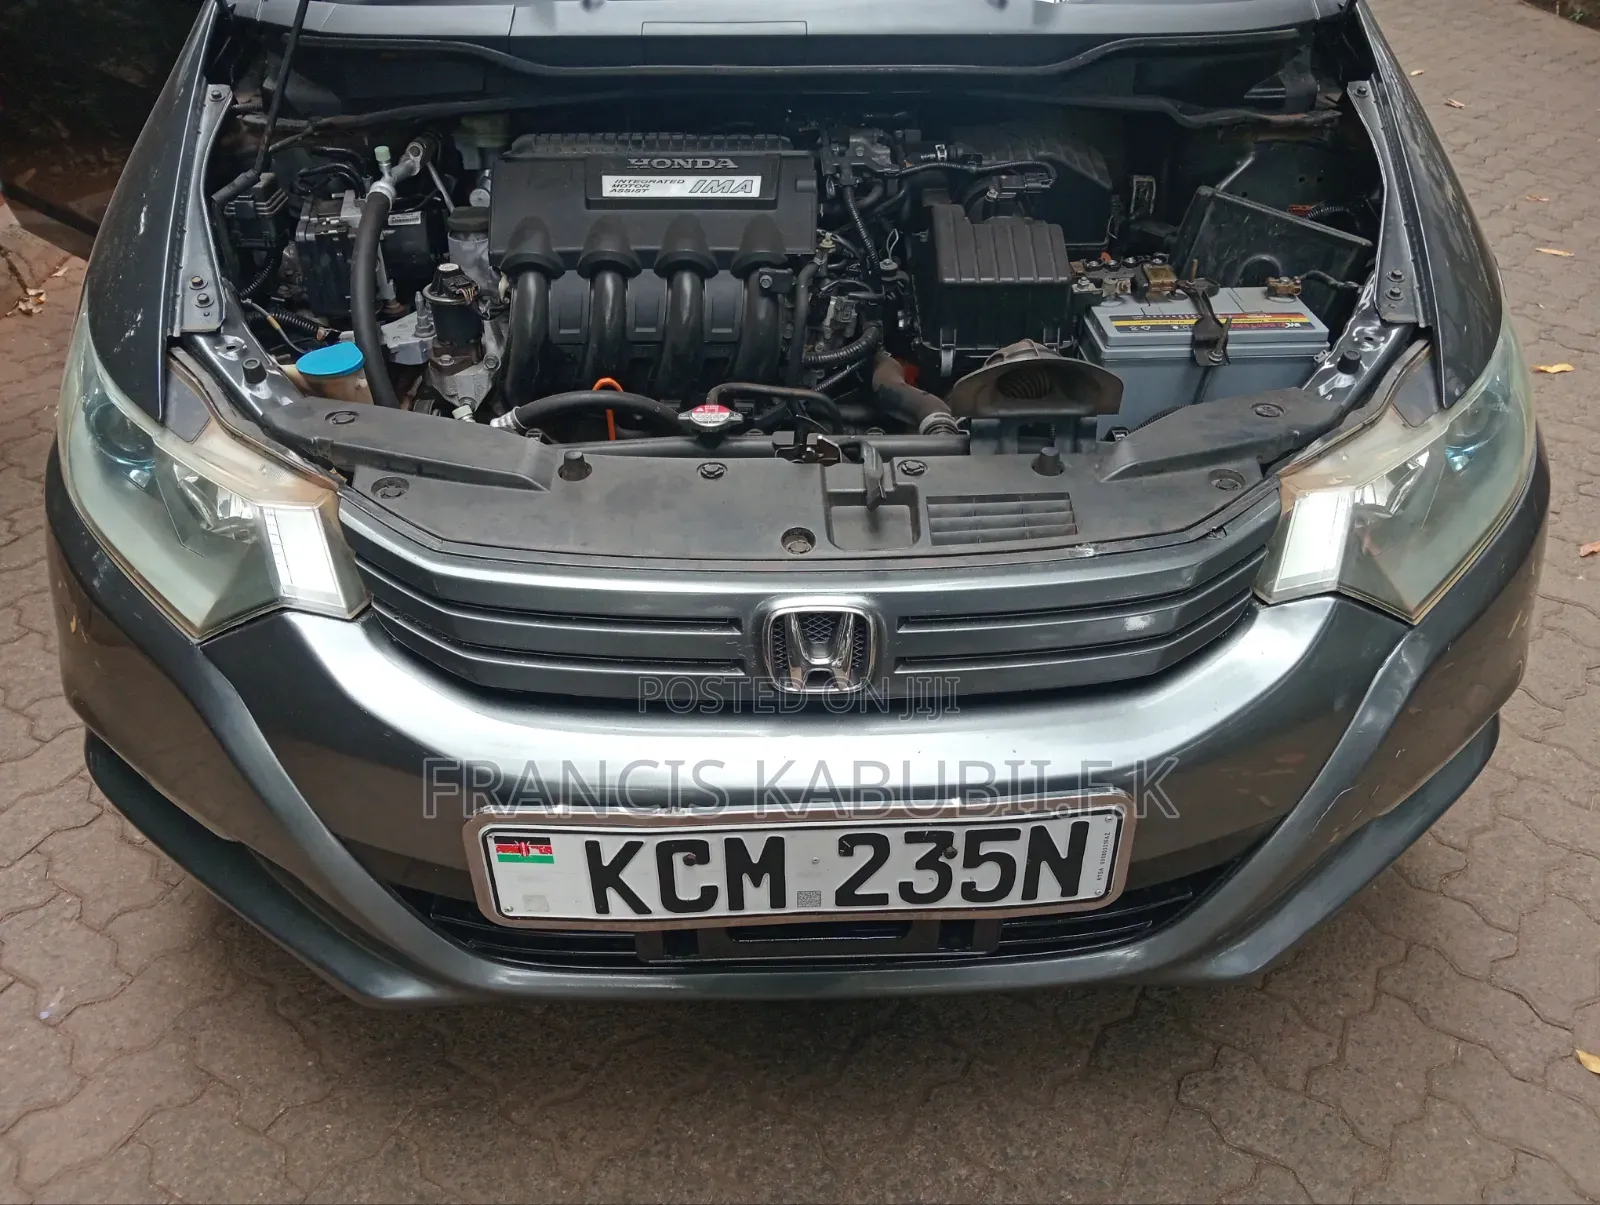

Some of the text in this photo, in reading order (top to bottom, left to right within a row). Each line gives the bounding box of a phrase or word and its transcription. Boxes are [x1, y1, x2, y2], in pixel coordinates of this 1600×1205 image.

[626, 158, 739, 170] HONDA
[688, 179, 754, 194] IMA
[585, 821, 1090, 914] KCM 235N
